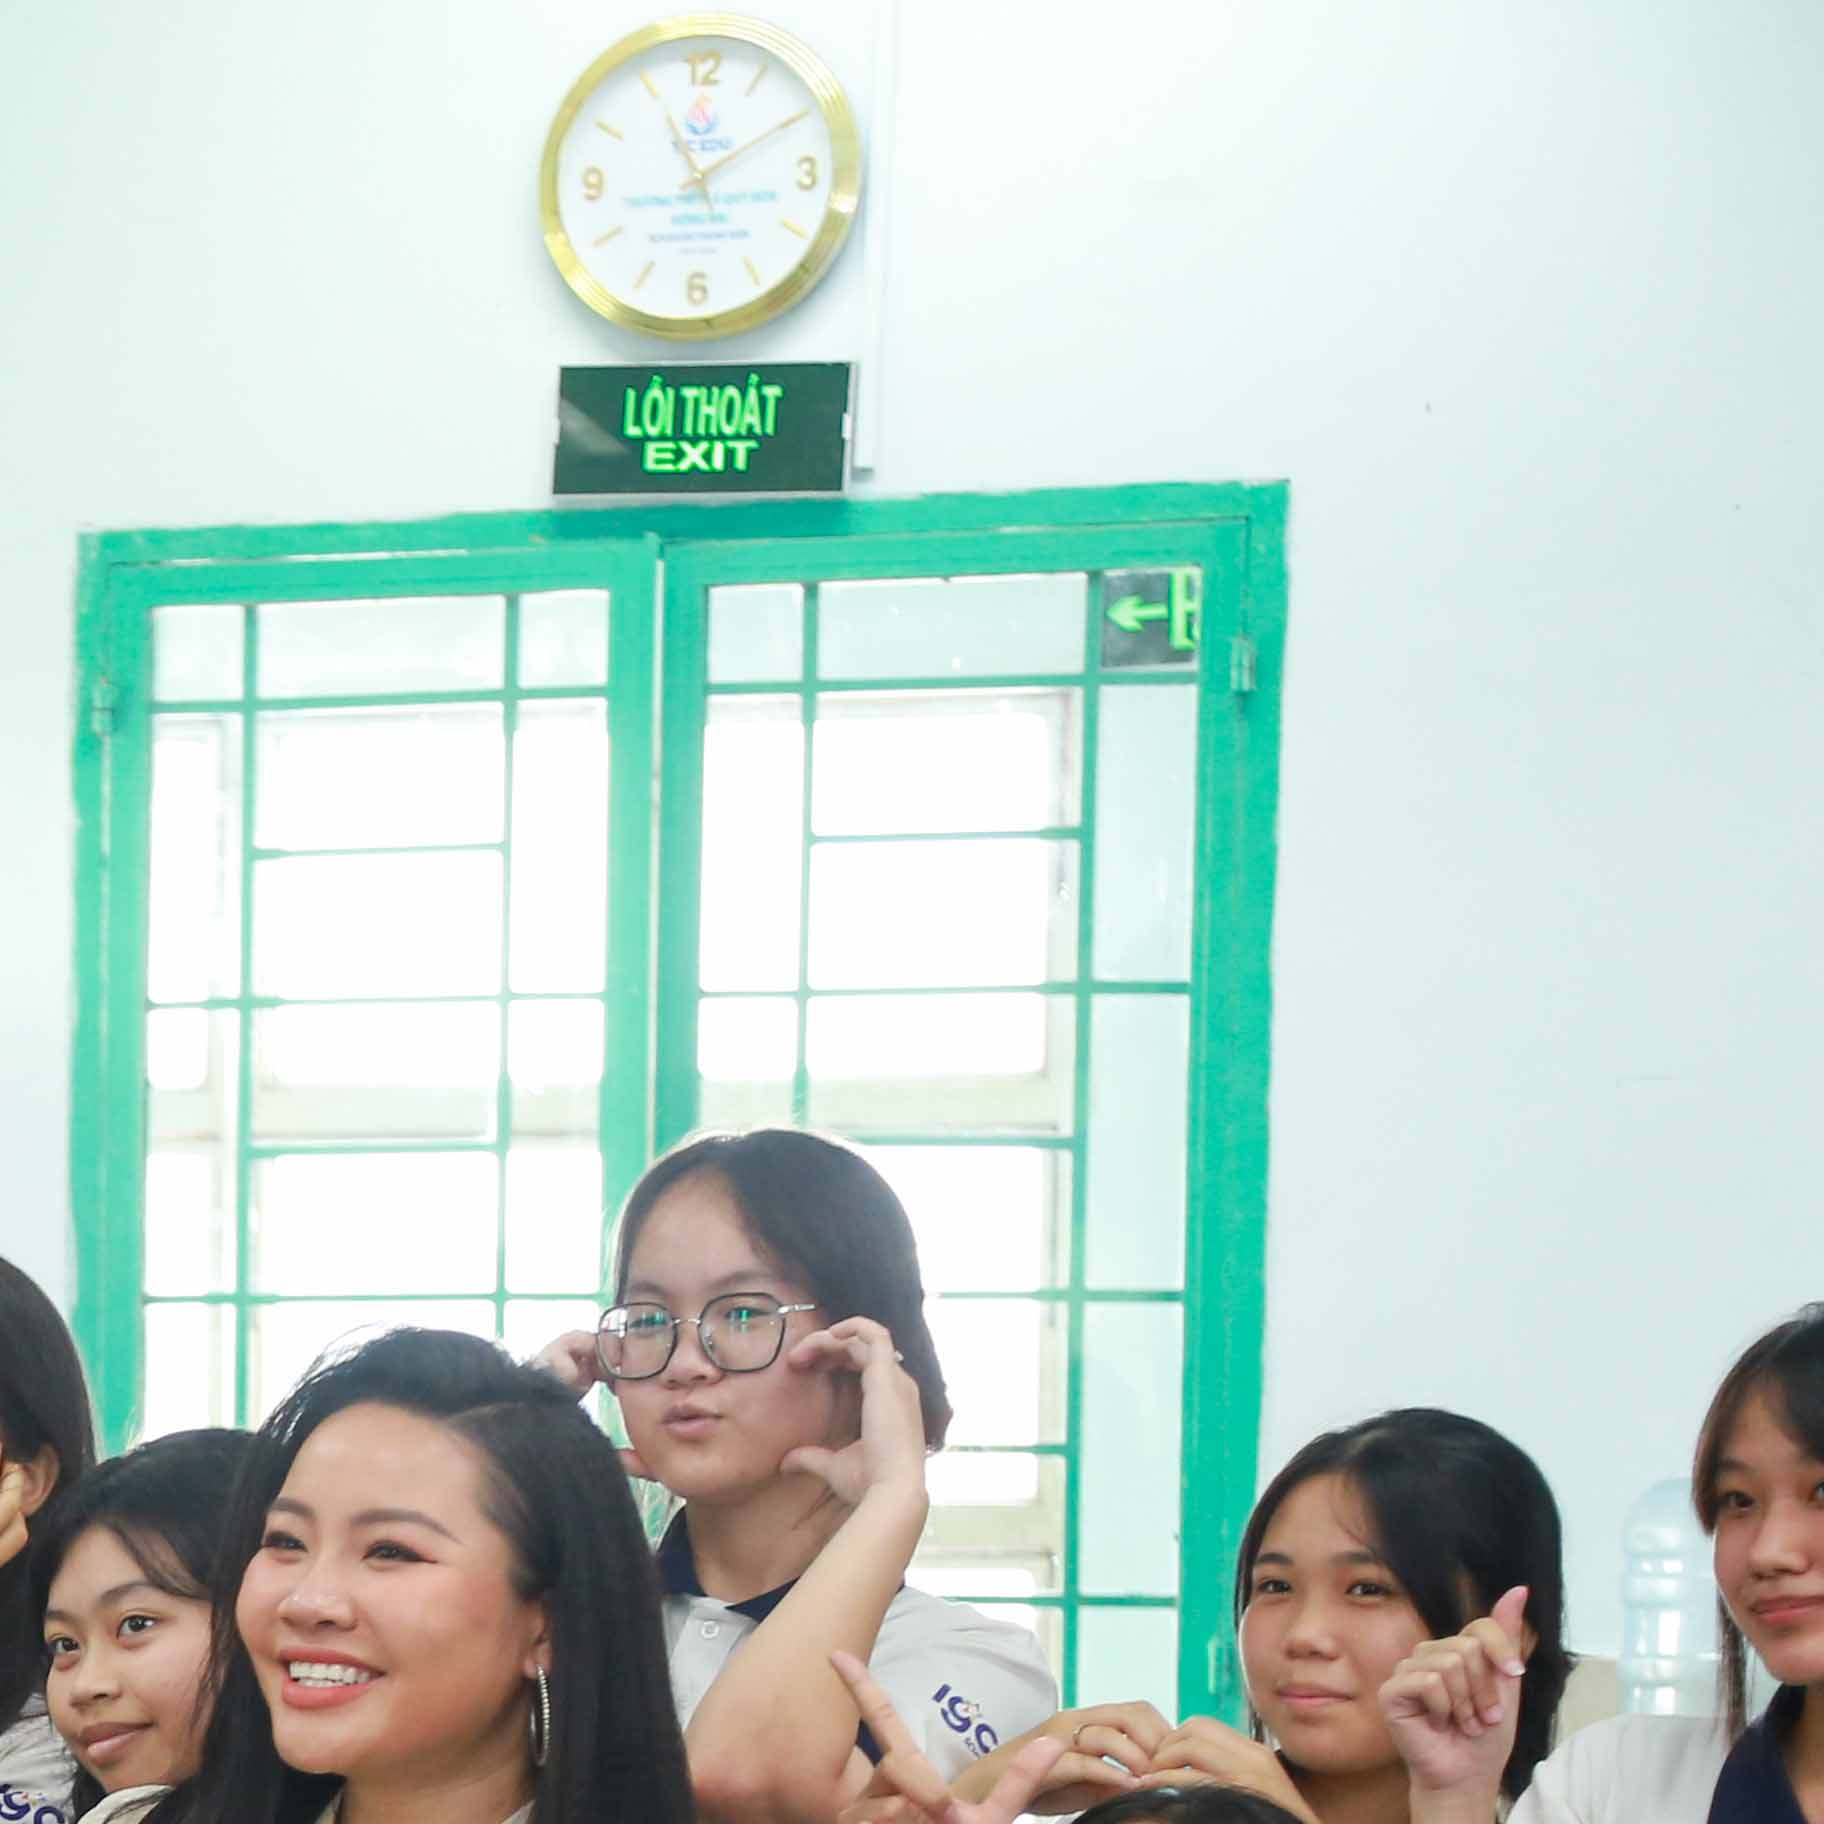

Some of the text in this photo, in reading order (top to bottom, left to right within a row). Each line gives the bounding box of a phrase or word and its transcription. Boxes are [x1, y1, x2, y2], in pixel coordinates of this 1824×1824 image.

[684, 50, 722, 86] 12
[582, 166, 604, 201] 9
[797, 156, 817, 191] 3
[687, 272, 708, 305] 6
[643, 440, 759, 473] EXIT
